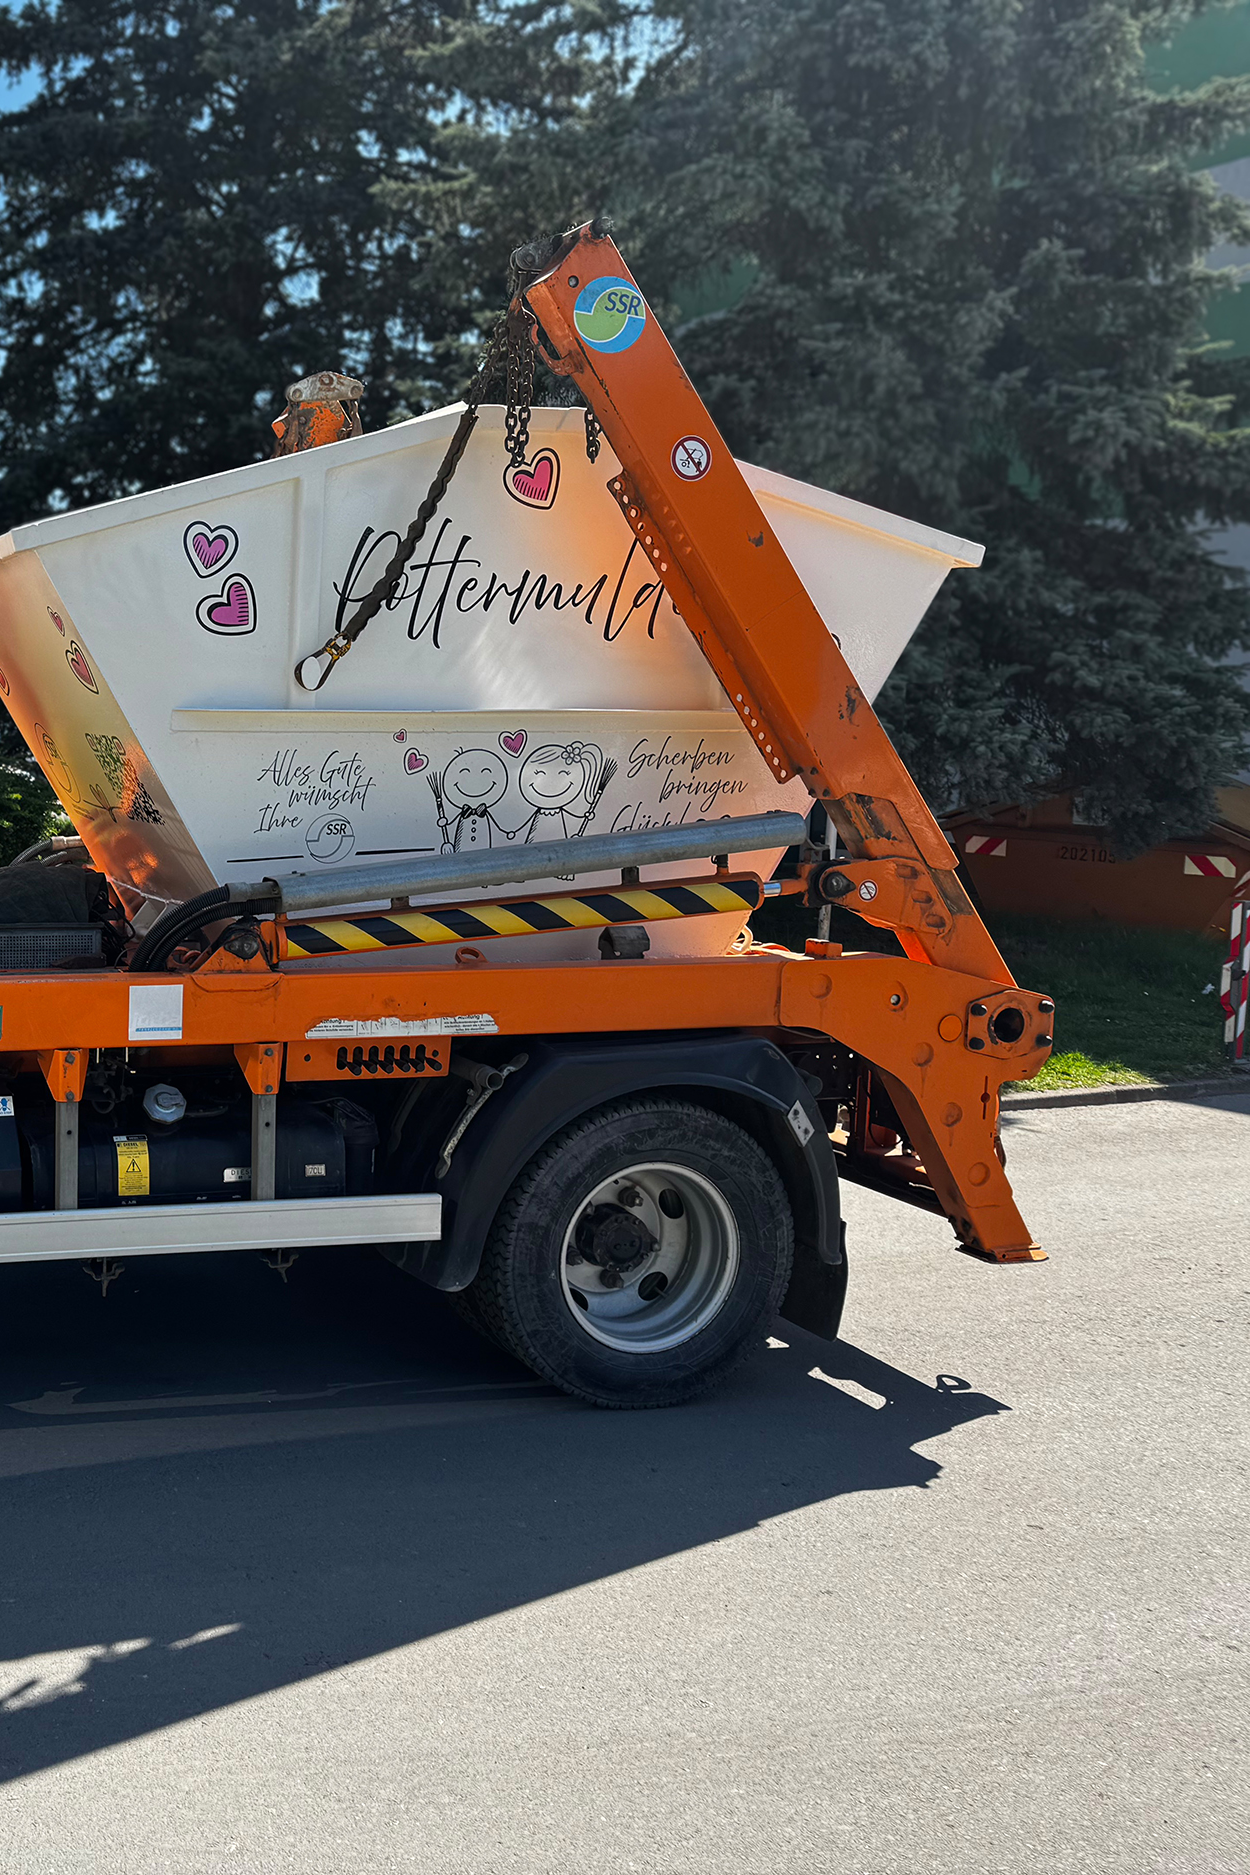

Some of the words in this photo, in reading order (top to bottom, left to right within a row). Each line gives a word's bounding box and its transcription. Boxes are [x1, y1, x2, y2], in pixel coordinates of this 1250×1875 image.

[604, 291, 642, 316] SSR
[257, 749, 316, 787] Alles
[319, 750, 366, 788] Gute
[627, 736, 735, 778] Scherben
[288, 775, 377, 811] wünscht
[658, 769, 749, 813] bringen
[253, 802, 303, 834] Ihre
[326, 823, 347, 836] SSR
